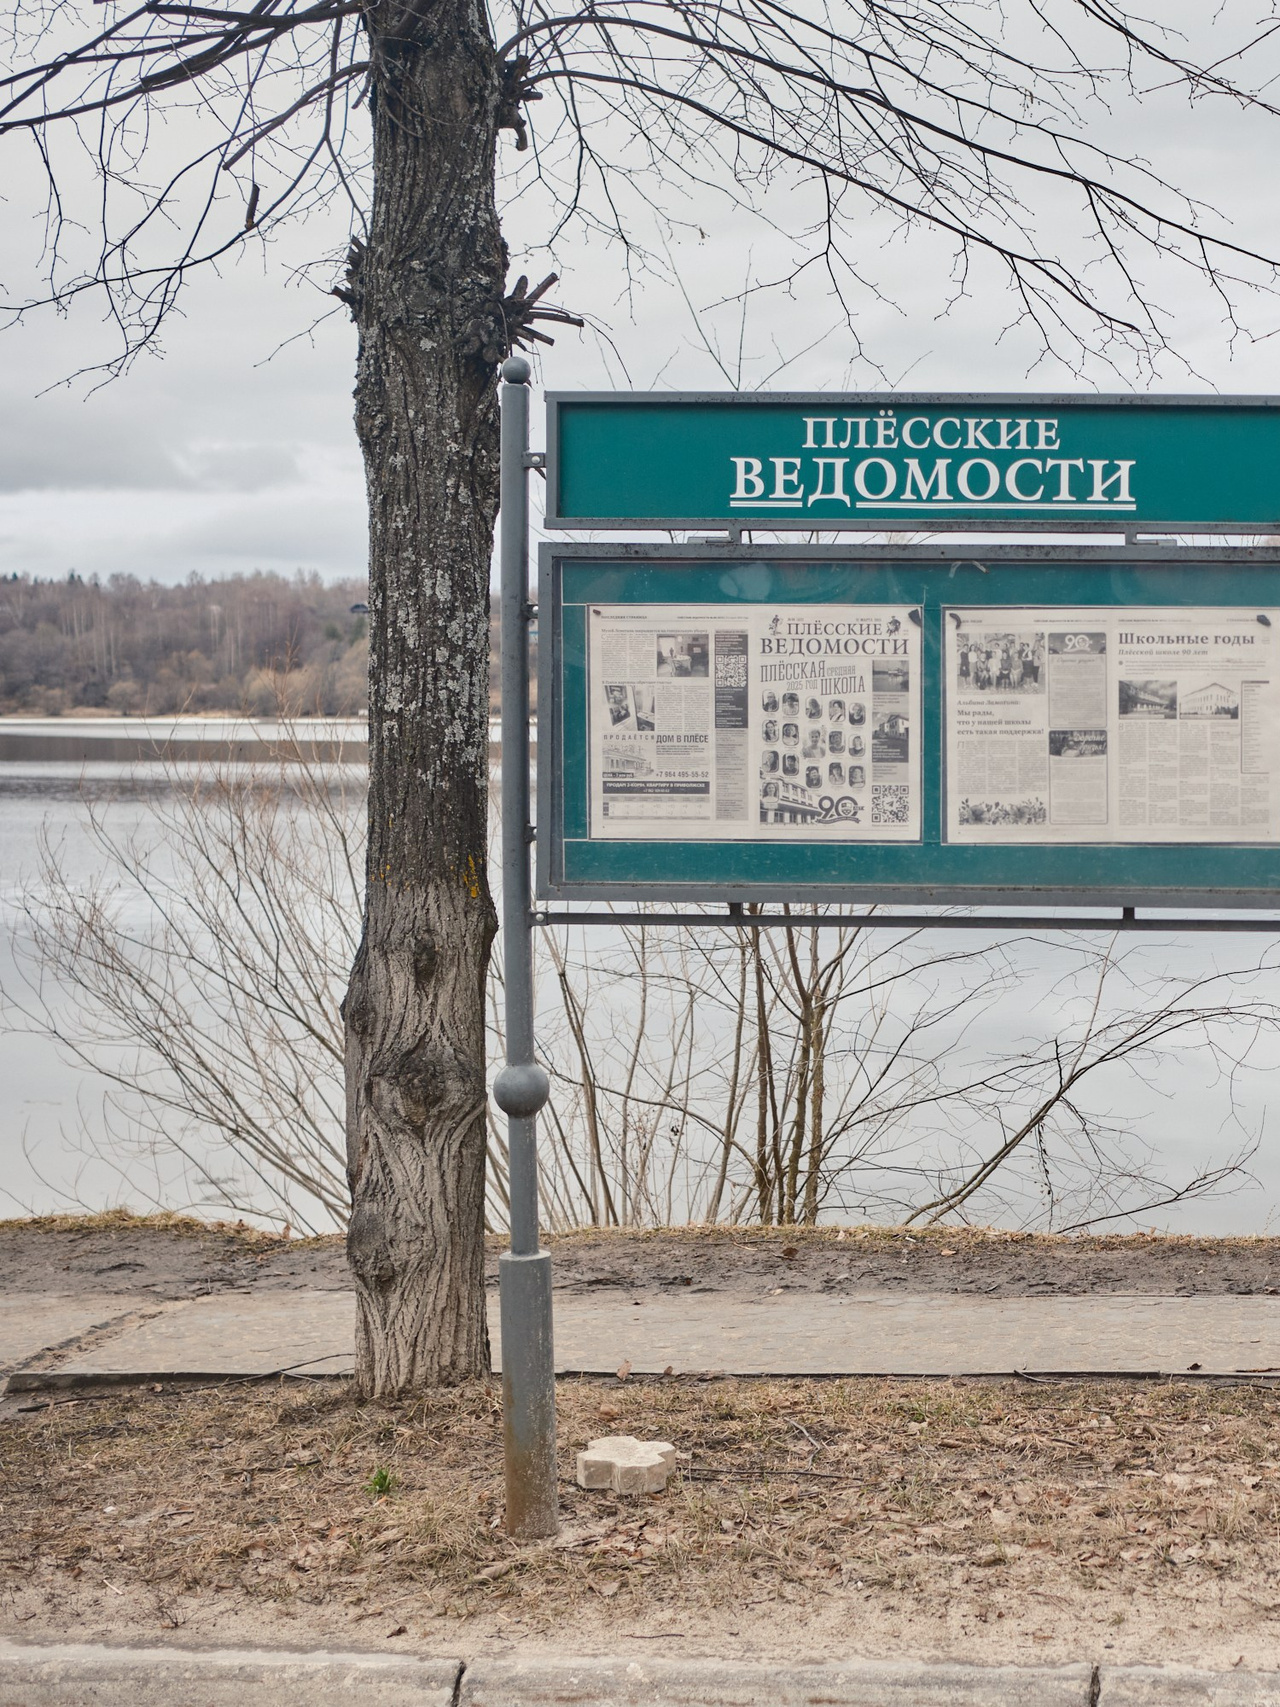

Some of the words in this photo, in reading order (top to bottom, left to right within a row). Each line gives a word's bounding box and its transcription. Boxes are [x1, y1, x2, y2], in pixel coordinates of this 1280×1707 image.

[802, 410, 1061, 449] ПЛЁССКИЕ
[730, 457, 1136, 507] ВЕДОМОСТИ
[787, 620, 882, 636] ПЛЁССКИЕ
[760, 637, 909, 656] ВЕДОМОСТИ
[1118, 632, 1209, 645] Школьные
[1214, 634, 1255, 647] годы
[760, 660, 826, 683] ПЛЁССКАЯ
[787, 681, 803, 691] 2025
[805, 679, 818, 690] ГОД
[820, 675, 866, 696] ШКОЛА
[604, 733, 655, 741] ПРОДАЁТСЯ
[656, 734, 674, 744] ДОМ
[677, 735, 682, 743] В
[684, 733, 709, 743] ПЛЁСЕ
[999, 728, 1044, 736] поддержка!
